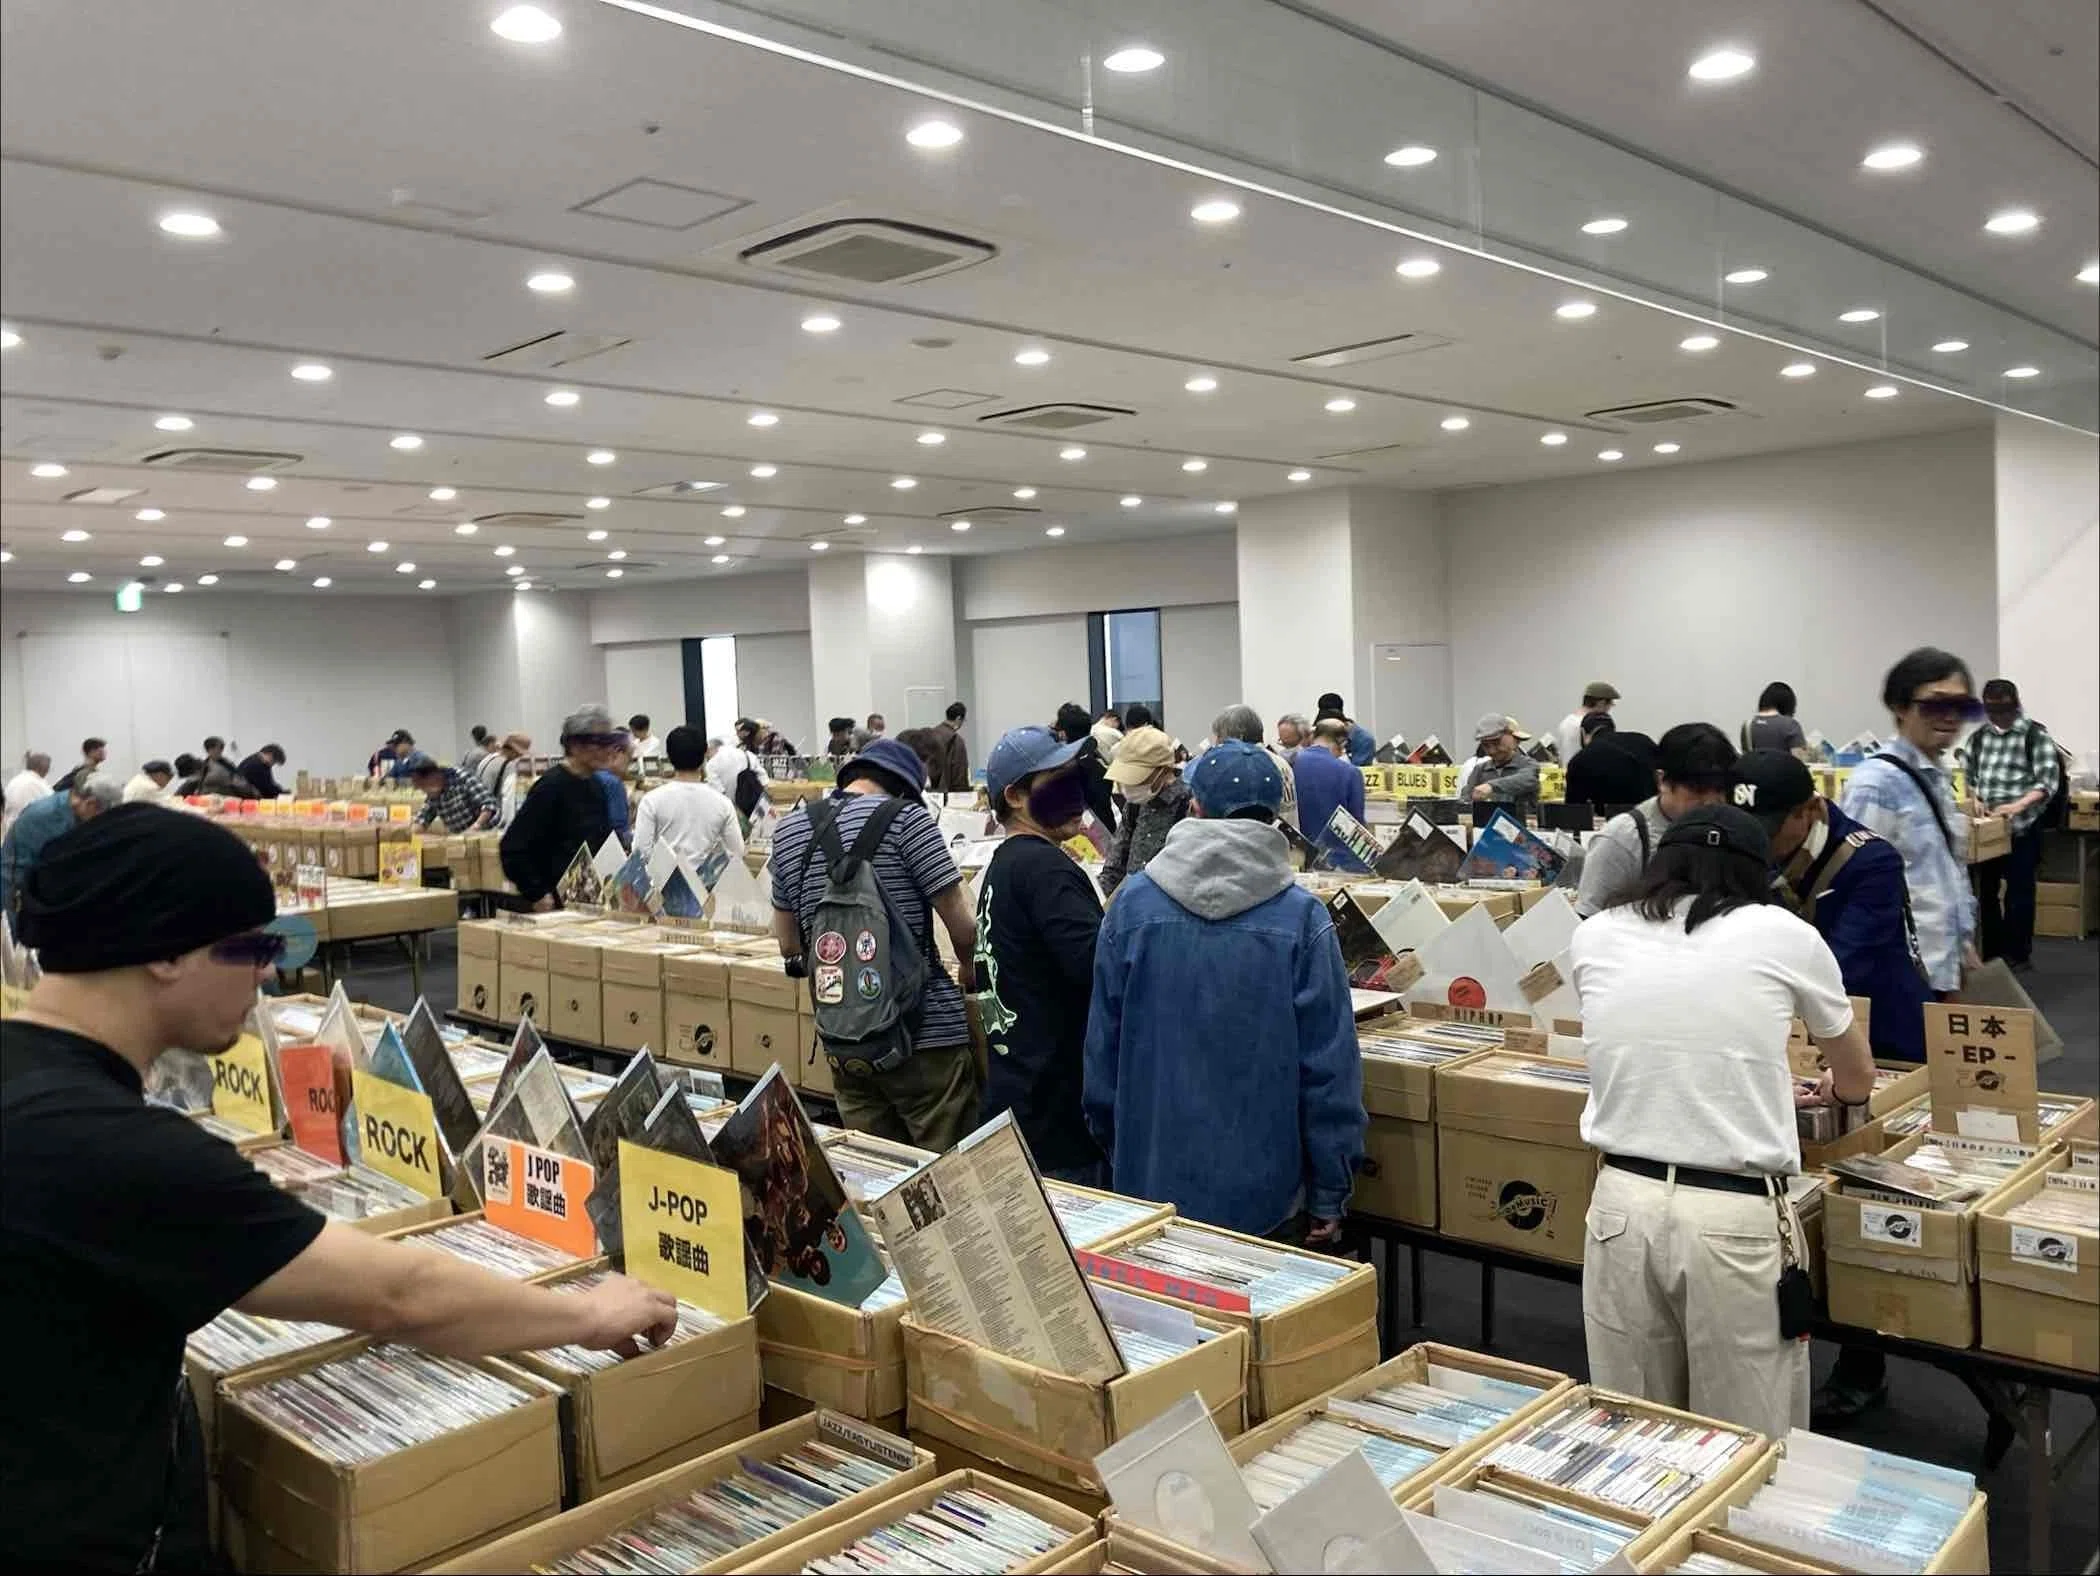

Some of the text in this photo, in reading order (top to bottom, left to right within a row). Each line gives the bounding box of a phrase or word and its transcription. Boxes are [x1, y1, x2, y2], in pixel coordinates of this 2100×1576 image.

[1364, 774, 1380, 788] ZZ
[1397, 772, 1428, 788] BLUES
[1947, 1013, 2007, 1039] 日本
[215, 1060, 264, 1104] ROCK
[308, 1087, 337, 1113] ROC
[364, 1113, 431, 1174] ROCK
[526, 1183, 566, 1218] 歌謡曲
[648, 1185, 708, 1226] J-POP
[658, 1231, 710, 1277] 歌謡曲
